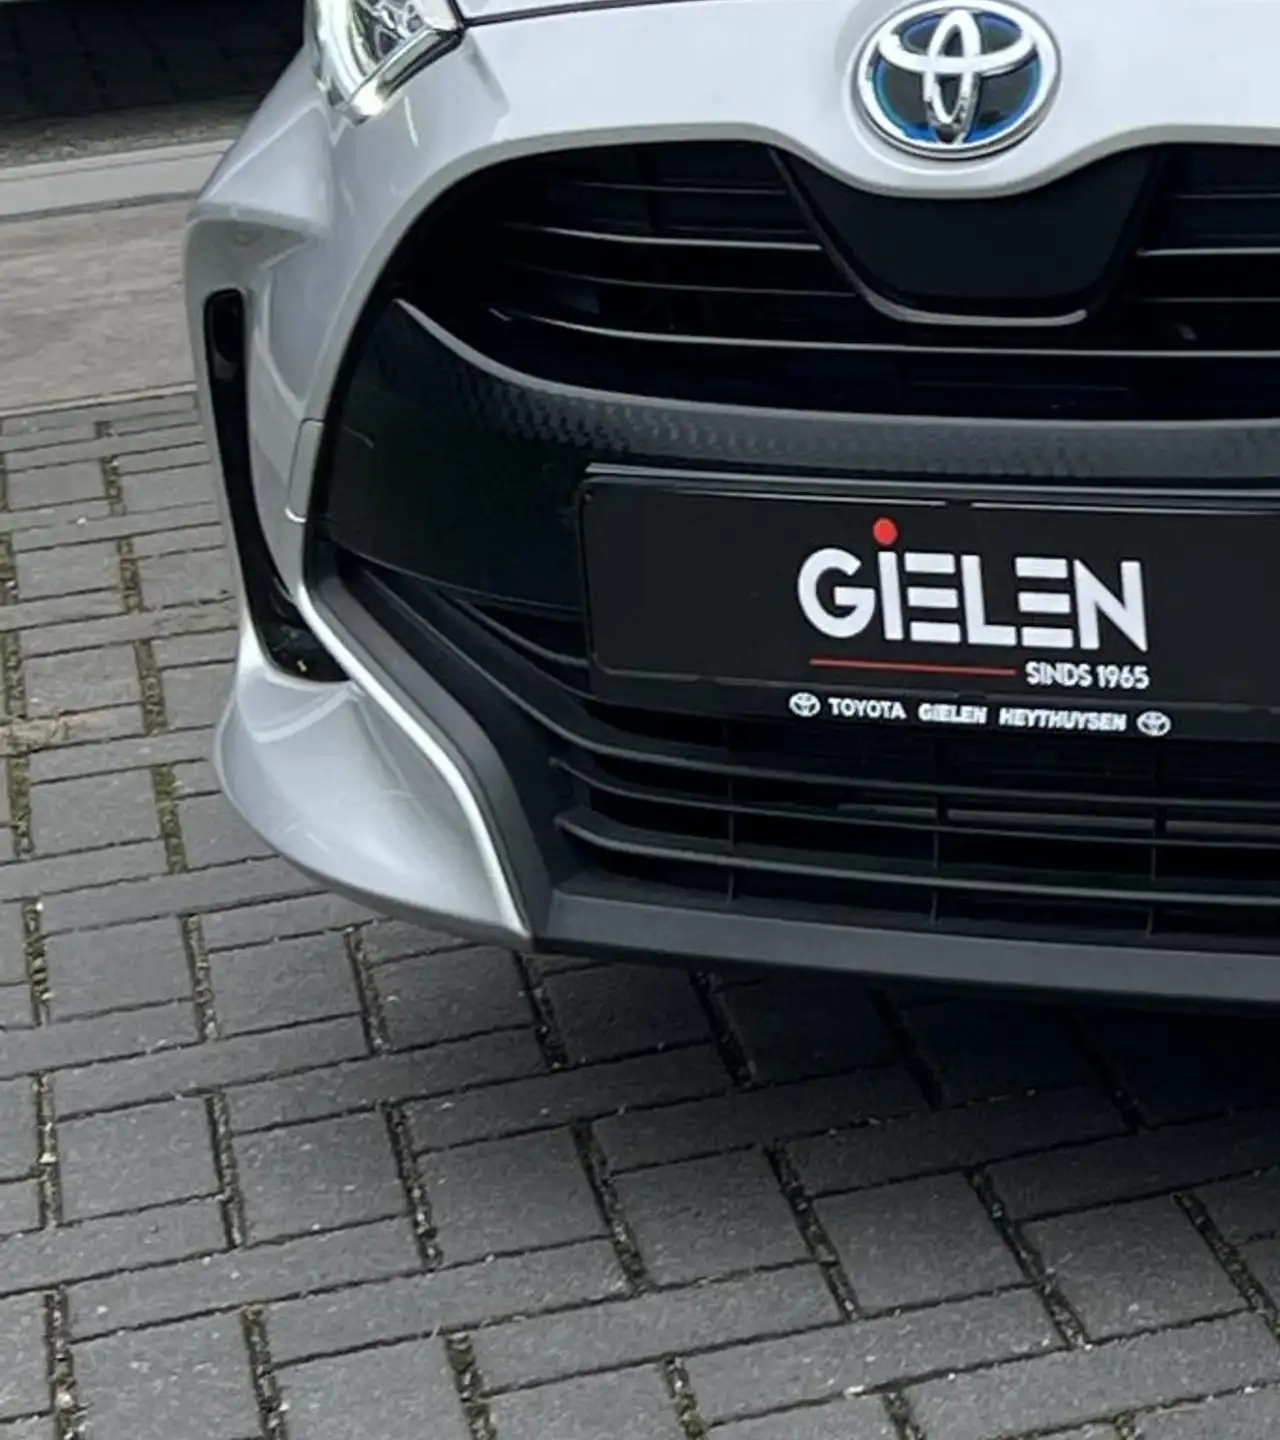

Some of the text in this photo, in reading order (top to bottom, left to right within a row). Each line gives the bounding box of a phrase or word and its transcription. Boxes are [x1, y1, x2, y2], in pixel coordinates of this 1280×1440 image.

[797, 516, 1148, 652] GIELEN
[1025, 661, 1150, 690] SINDS 1965
[827, 697, 1127, 732] TOYOTA GIELEN HEYTHUYSEN
